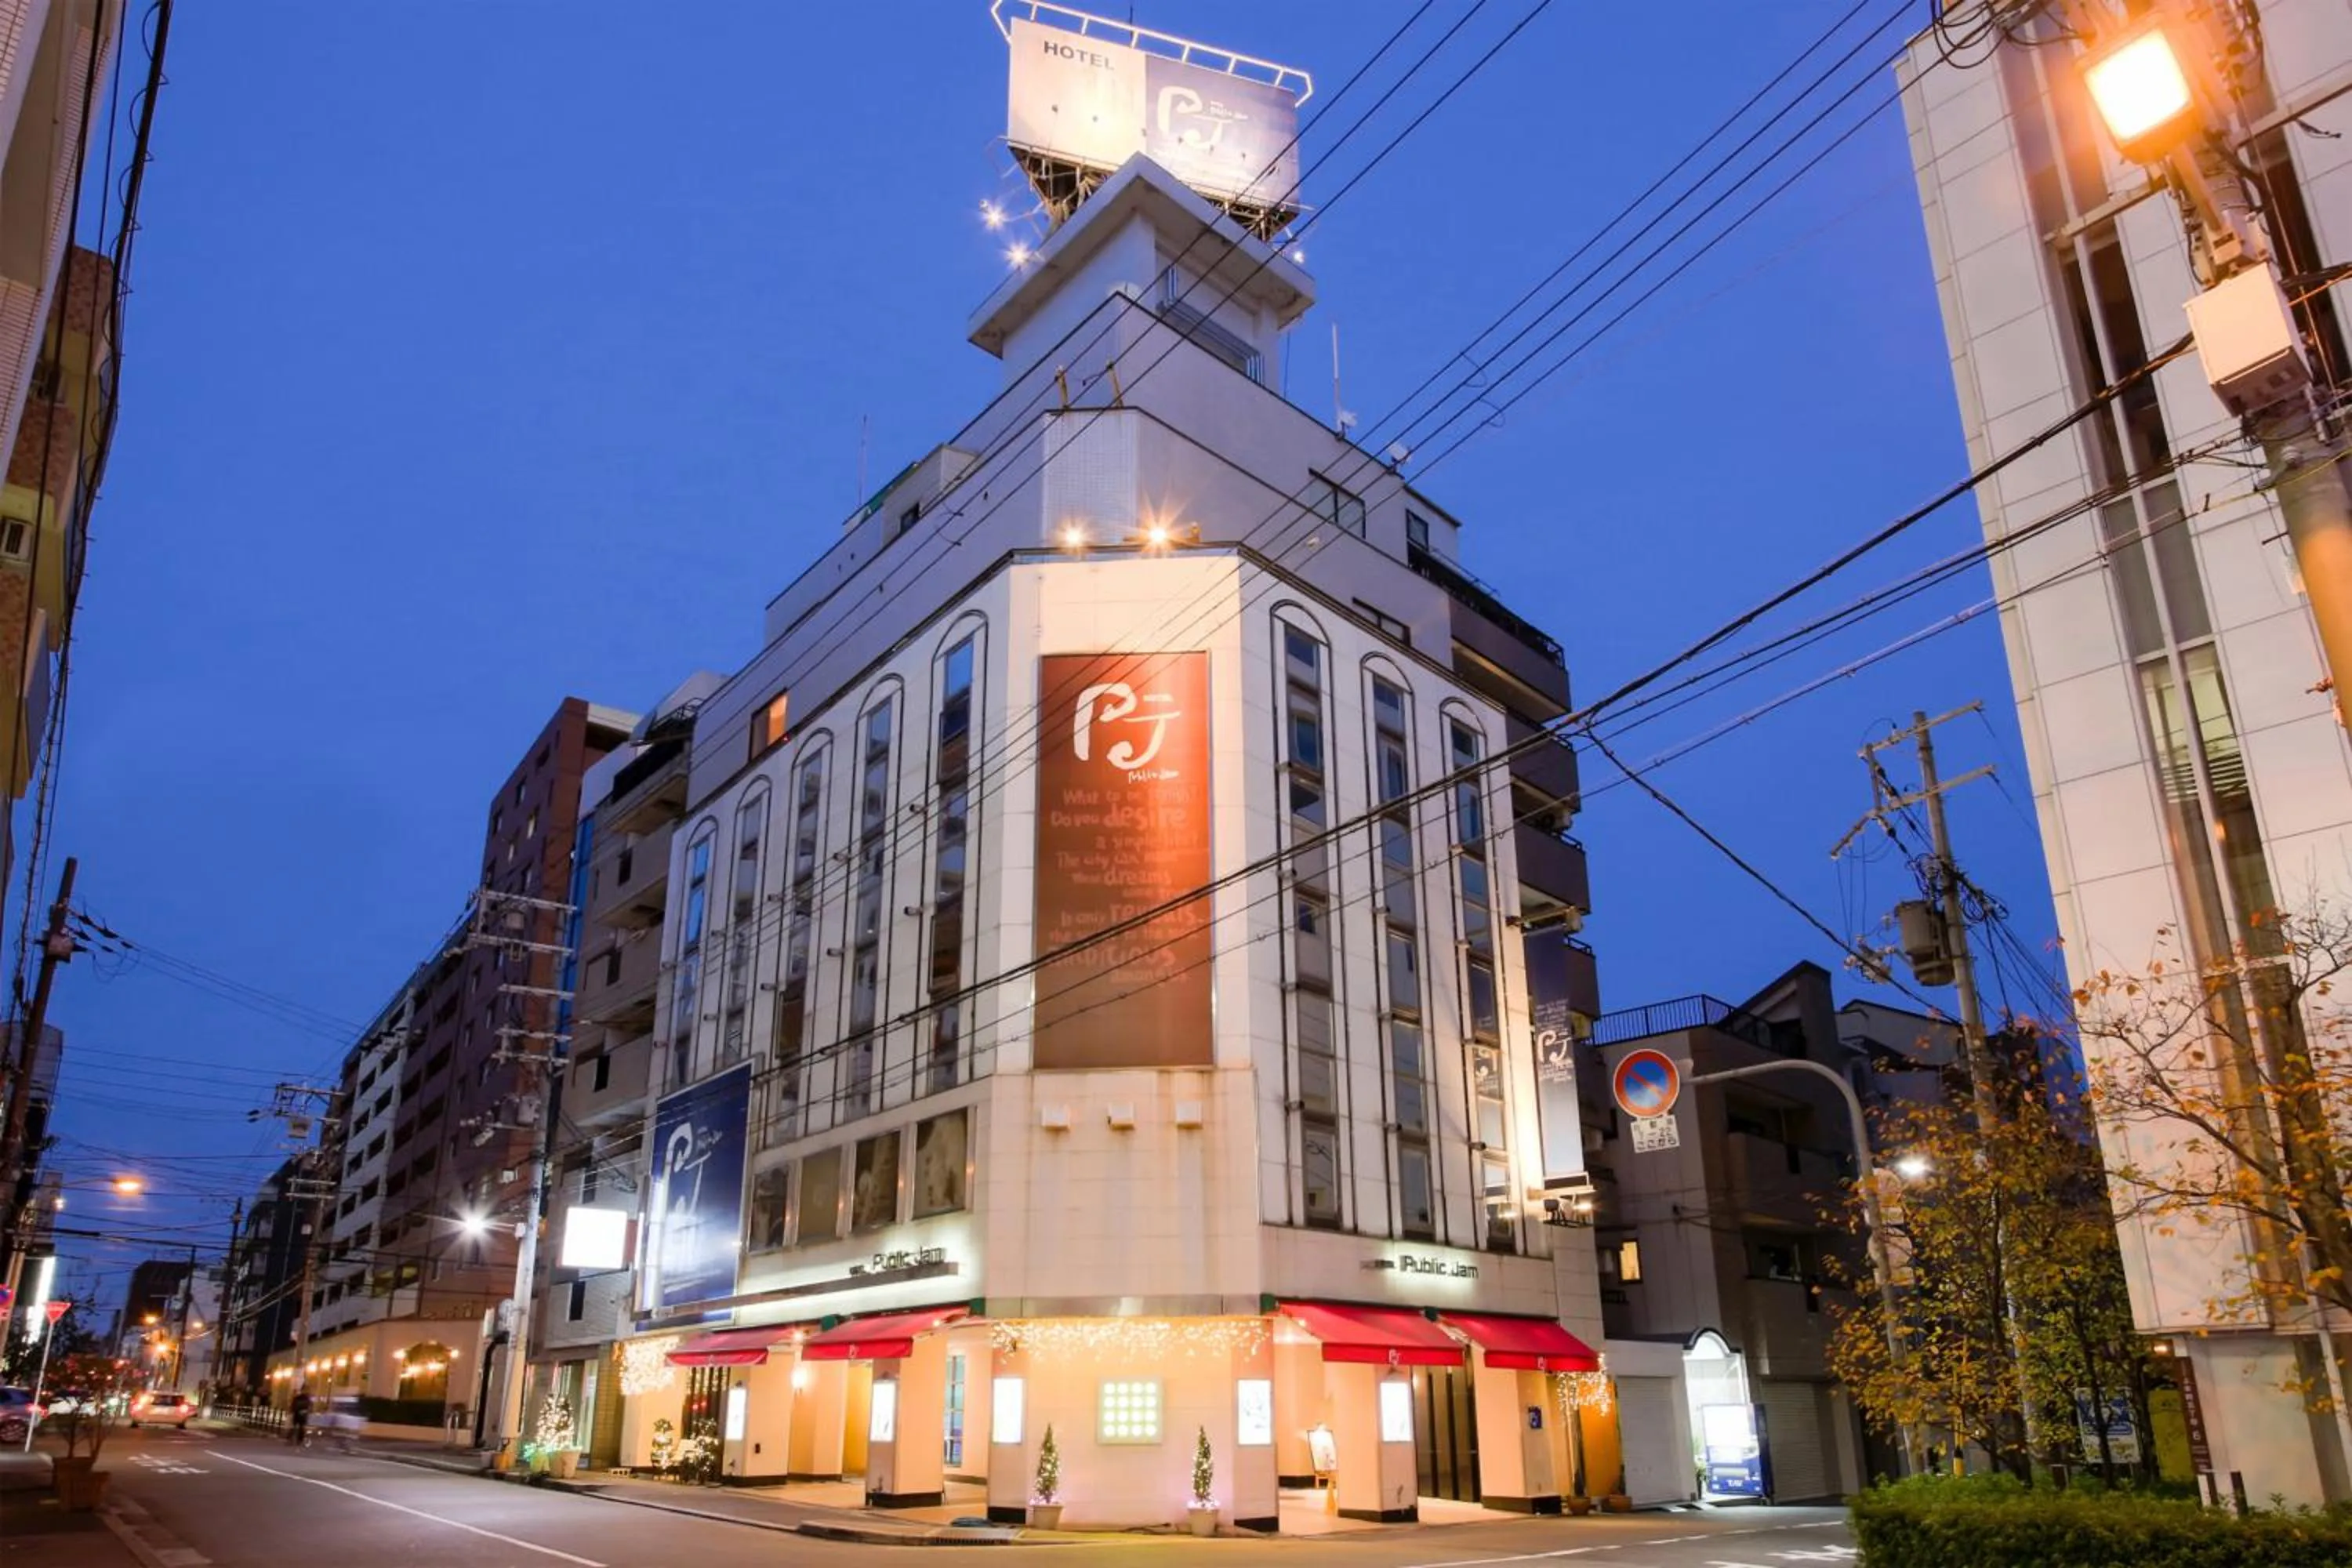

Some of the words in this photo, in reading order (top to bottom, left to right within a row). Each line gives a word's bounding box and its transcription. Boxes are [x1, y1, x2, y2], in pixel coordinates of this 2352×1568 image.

[1044, 41, 1114, 71] HOTEL
[1103, 802, 1189, 832] desire
[1103, 865, 1172, 887] dreams
[1399, 1254, 1447, 1276] Public
[1451, 1260, 1479, 1281] Jam
